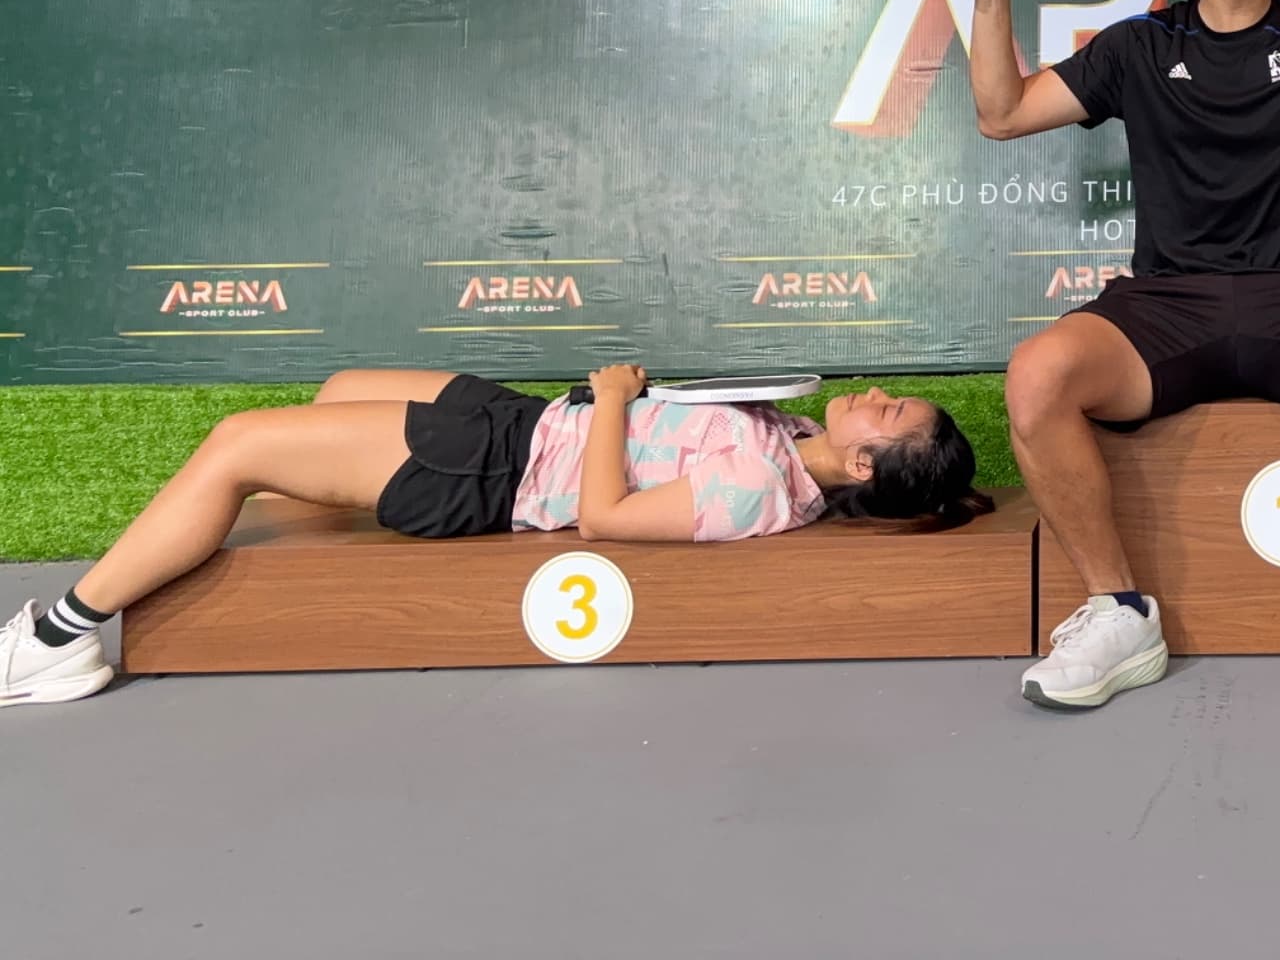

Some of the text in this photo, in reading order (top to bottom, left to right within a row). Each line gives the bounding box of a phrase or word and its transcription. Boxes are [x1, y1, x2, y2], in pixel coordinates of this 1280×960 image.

[832, 185, 886, 206] 47C
[903, 178, 964, 205] PHÙ
[978, 174, 1067, 204] ĐỔNG
[1083, 180, 1131, 201] THI
[1081, 219, 1136, 241] HOT
[160, 280, 288, 313] ARENA
[458, 276, 583, 308] ARENA
[752, 271, 877, 304] ARENA
[1045, 266, 1134, 298] ARE
[555, 574, 598, 639] 3
